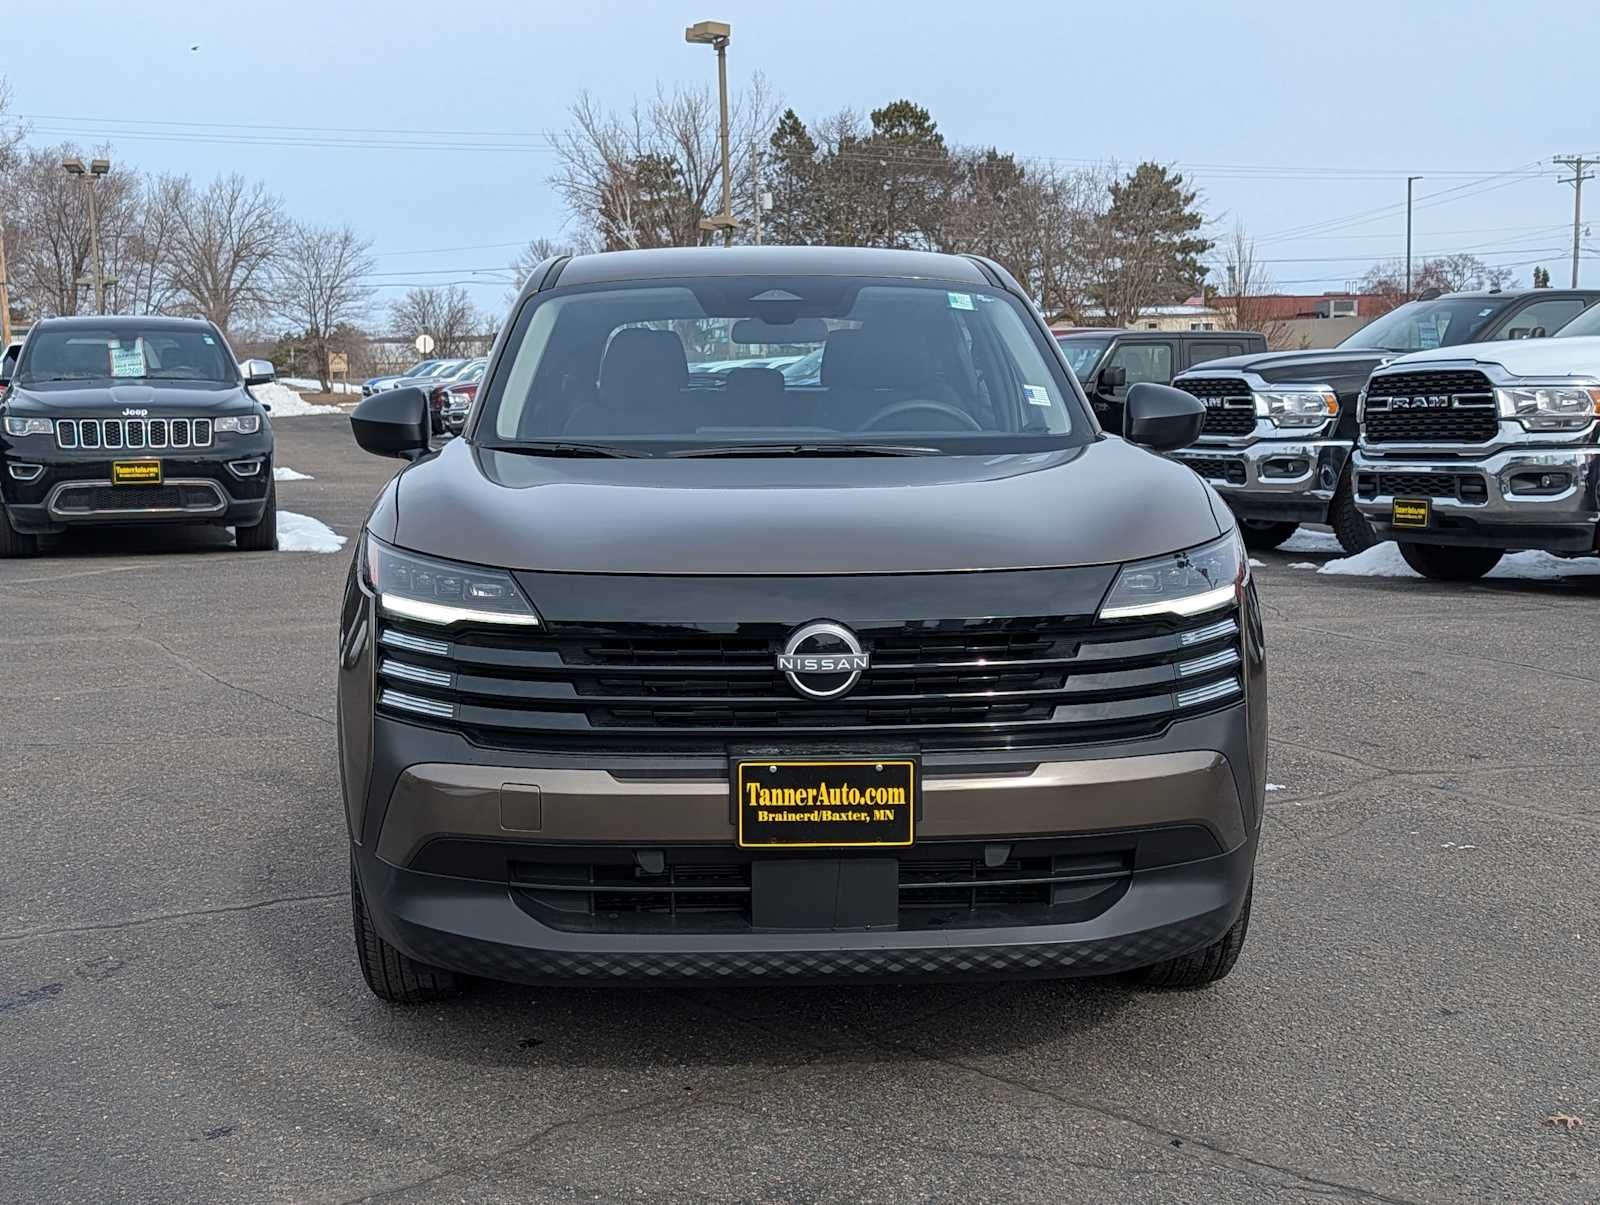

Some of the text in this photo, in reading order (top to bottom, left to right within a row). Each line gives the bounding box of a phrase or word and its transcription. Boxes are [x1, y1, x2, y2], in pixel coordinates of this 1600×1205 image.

[1392, 396, 1449, 409] RAM
[122, 408, 148, 417] Jeep
[779, 656, 867, 671] NISSAN
[746, 782, 906, 806] TannerAuto.com
[758, 809, 895, 823] Brainerd/Baxter, MN
